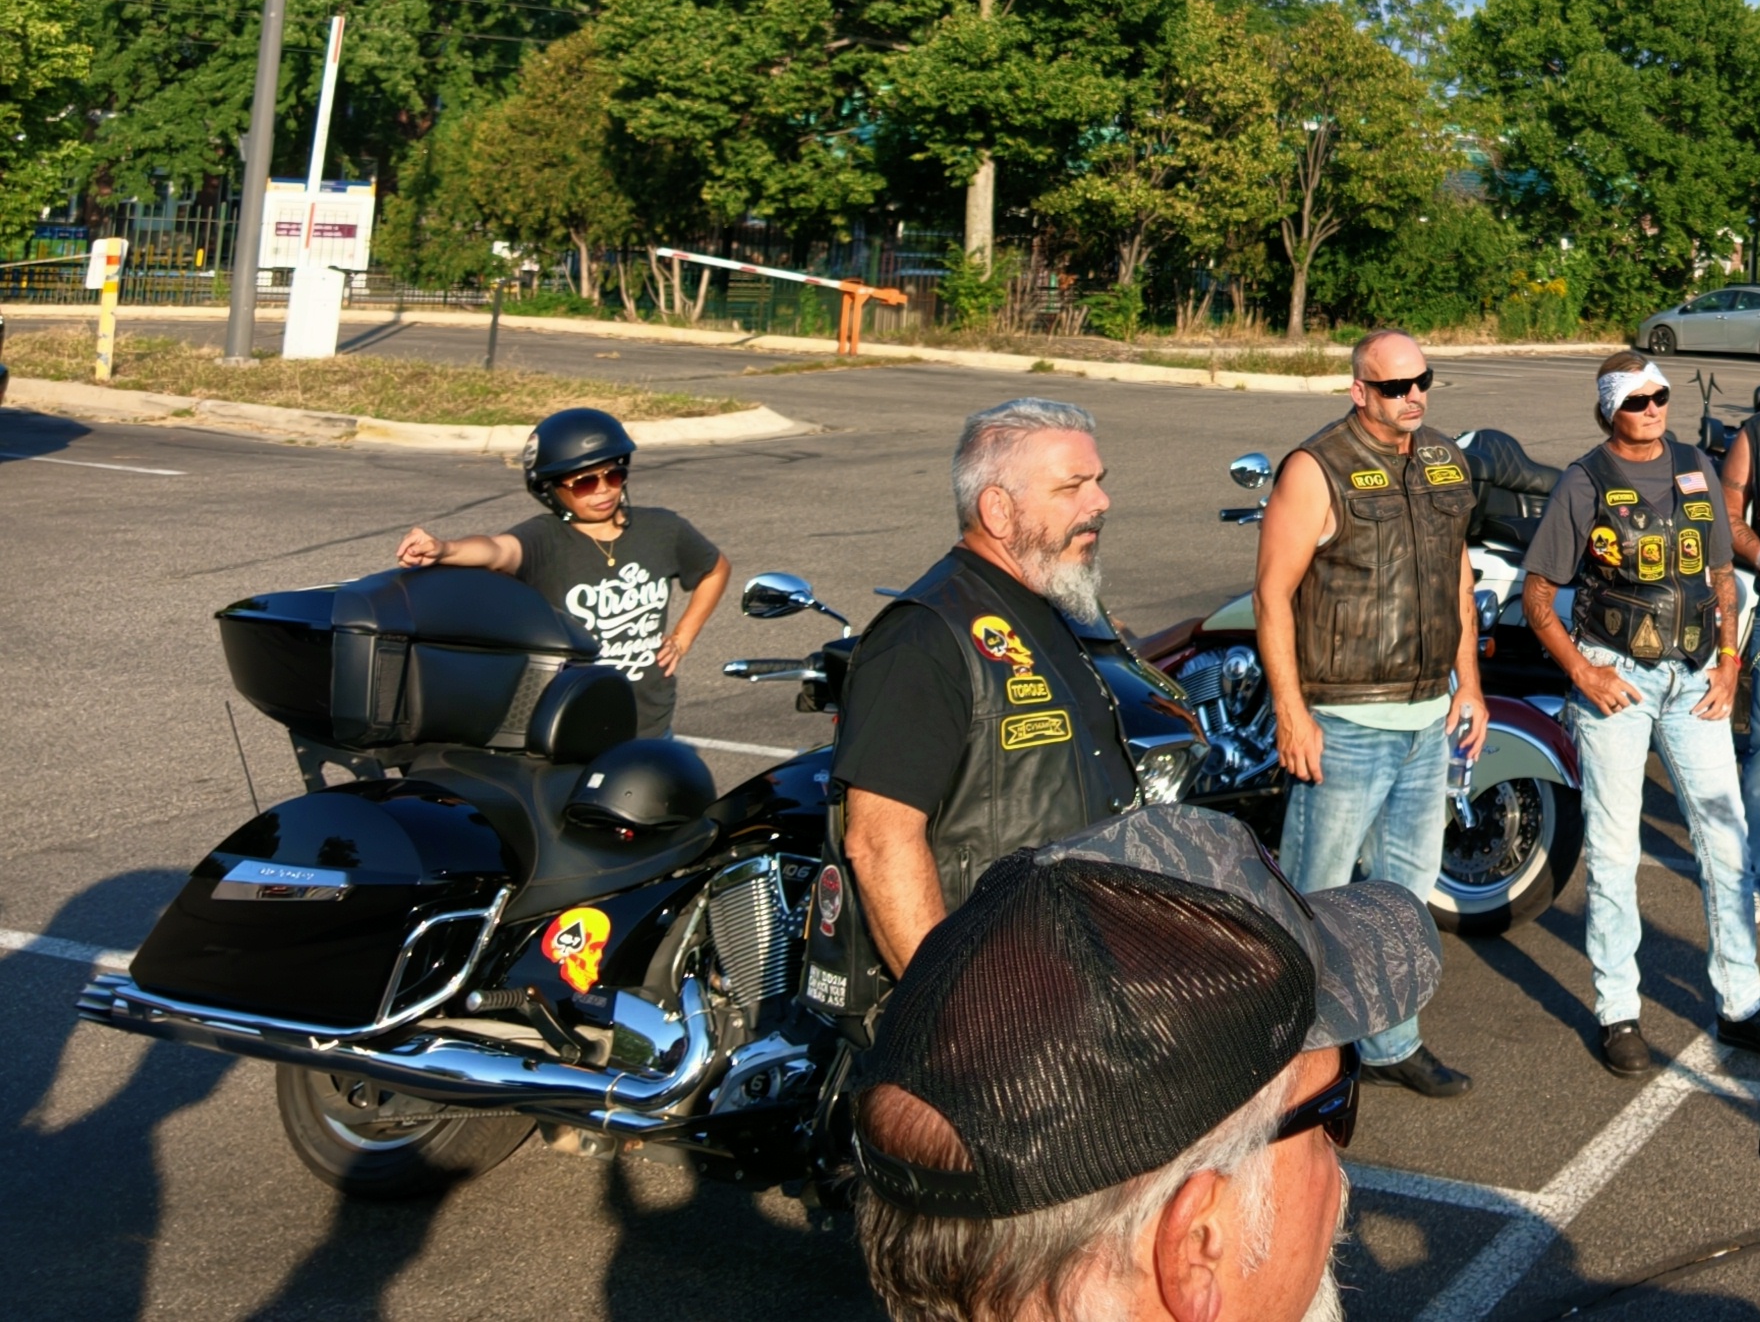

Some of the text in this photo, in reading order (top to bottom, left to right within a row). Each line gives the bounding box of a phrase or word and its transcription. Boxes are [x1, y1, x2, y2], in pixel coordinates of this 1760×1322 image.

[1355, 475, 1384, 487] ROG
[618, 562, 650, 590] Be
[565, 577, 668, 631] Strong
[1011, 683, 1048, 698] TORQUE
[782, 864, 812, 878] 106
